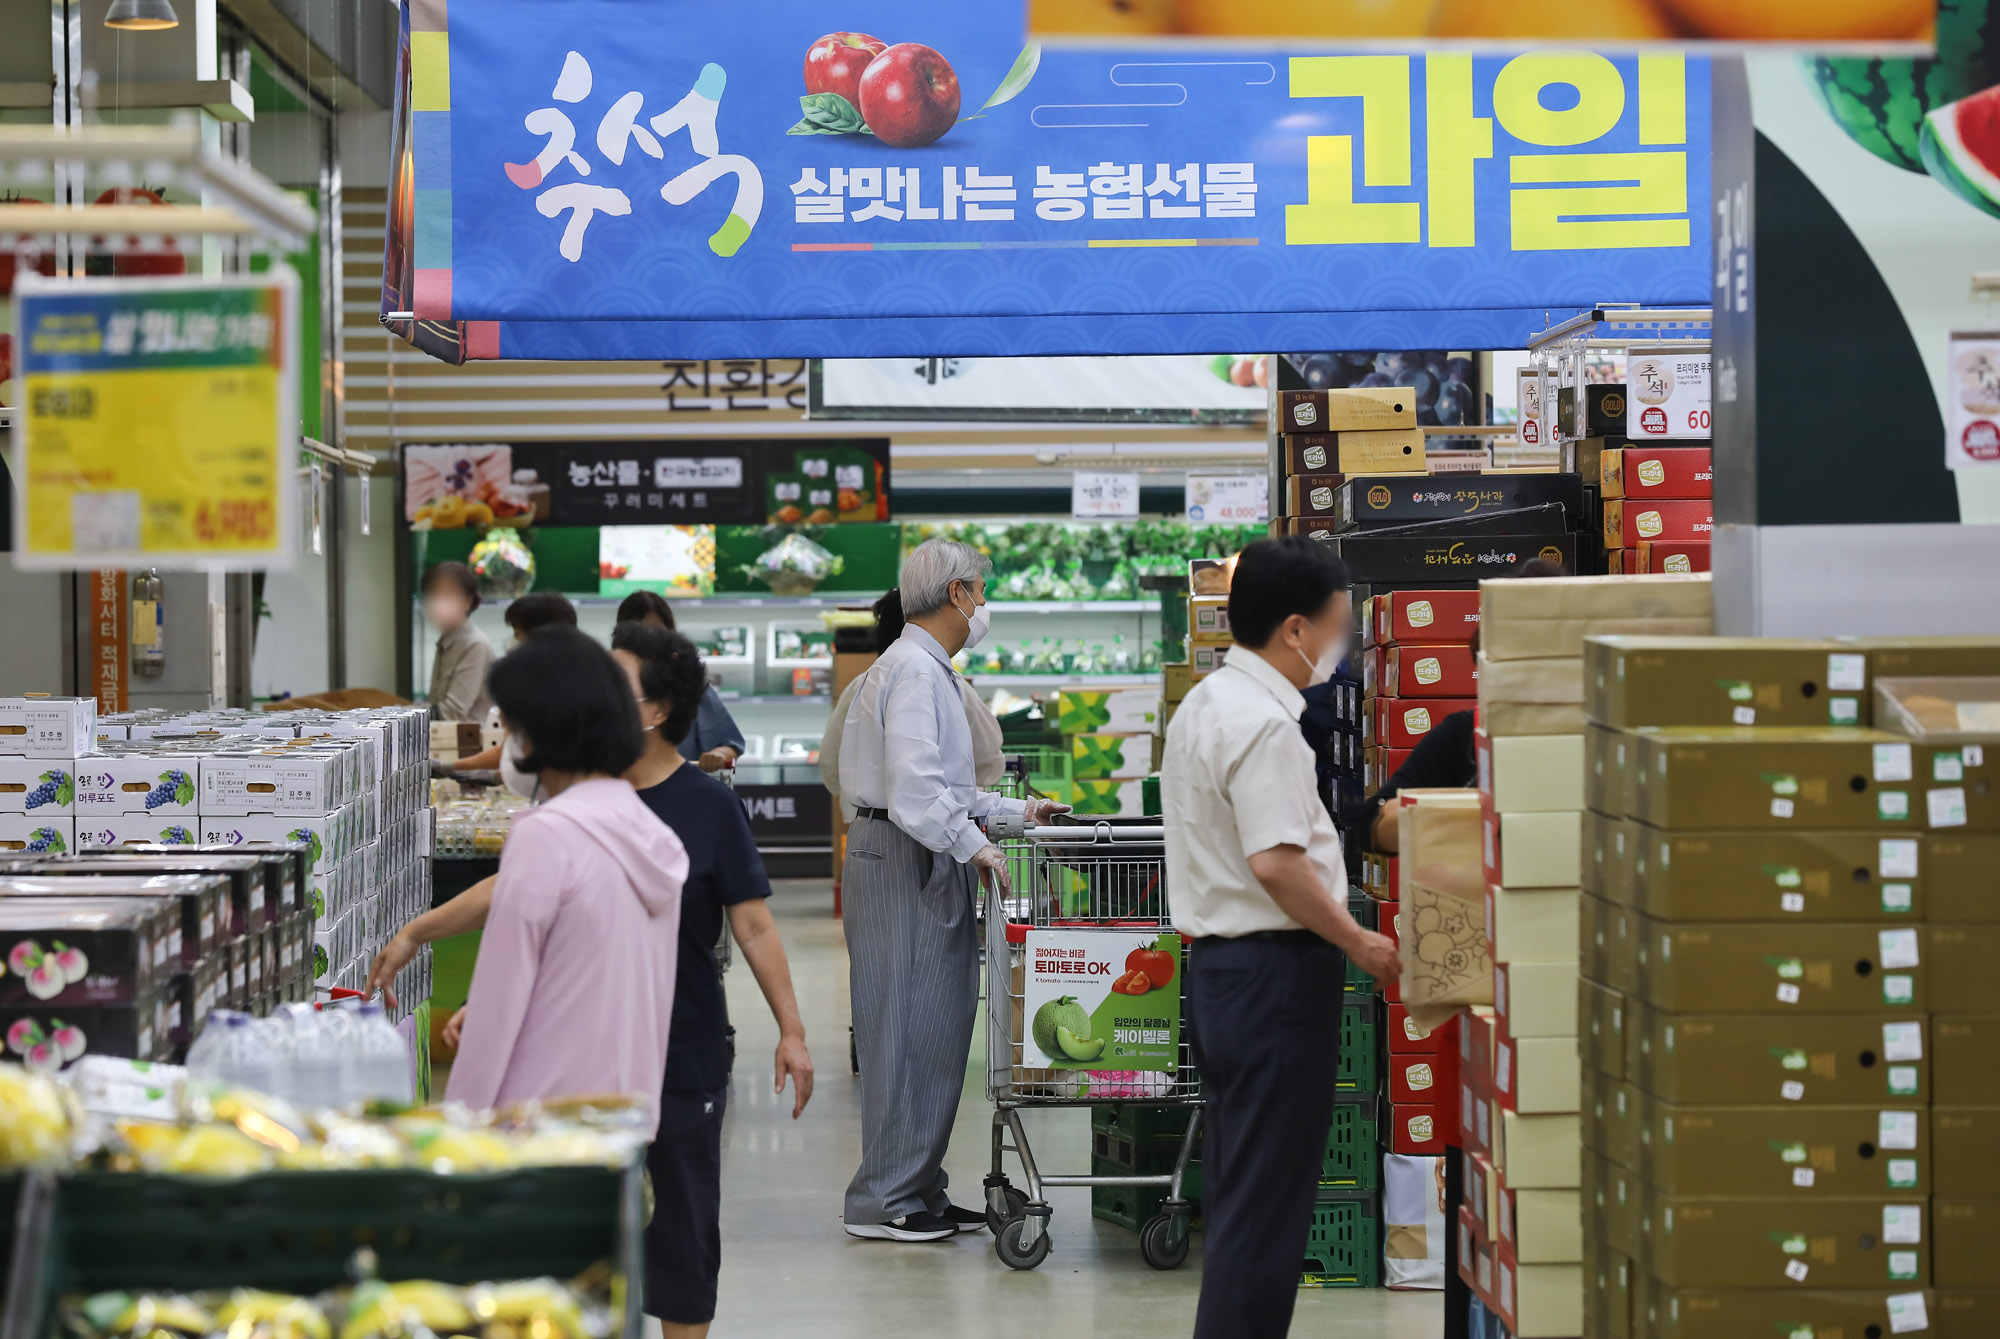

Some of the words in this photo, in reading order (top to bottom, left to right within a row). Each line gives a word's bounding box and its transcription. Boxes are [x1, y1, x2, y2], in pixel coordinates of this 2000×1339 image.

[1285, 49, 1691, 251] 과일
[504, 50, 764, 262] 추석
[789, 165, 1017, 223] 살맛나는
[1032, 161, 1258, 222] 농협선물
[1676, 363, 1699, 374] 프리미엄
[1640, 364, 1664, 397] 추석
[1605, 400, 1621, 411] GOLD
[568, 461, 640, 487] 농산물
[1641, 470, 1661, 478] 뜨라네
[1371, 490, 1388, 503] GOLD
[1219, 507, 1257, 518] 48,000
[1639, 521, 1660, 529] 뜨라네
[1667, 563, 1688, 573] 뜨라네
[1410, 610, 1431, 618] 뜨라네
[1418, 667, 1438, 676] 뜨라네
[1407, 717, 1428, 726] 뜨라네
[78, 793, 116, 804] 머루포도
[1035, 948, 1067, 958] 젊어지는
[1069, 949, 1086, 959] 비결
[1114, 1018, 1141, 1028] 입안의
[1143, 1018, 1171, 1028] 달콤함
[1114, 1030, 1171, 1045] 케이멜론
[1409, 1073, 1430, 1082] 뜨라네
[1411, 1124, 1432, 1133] 뜨라네
